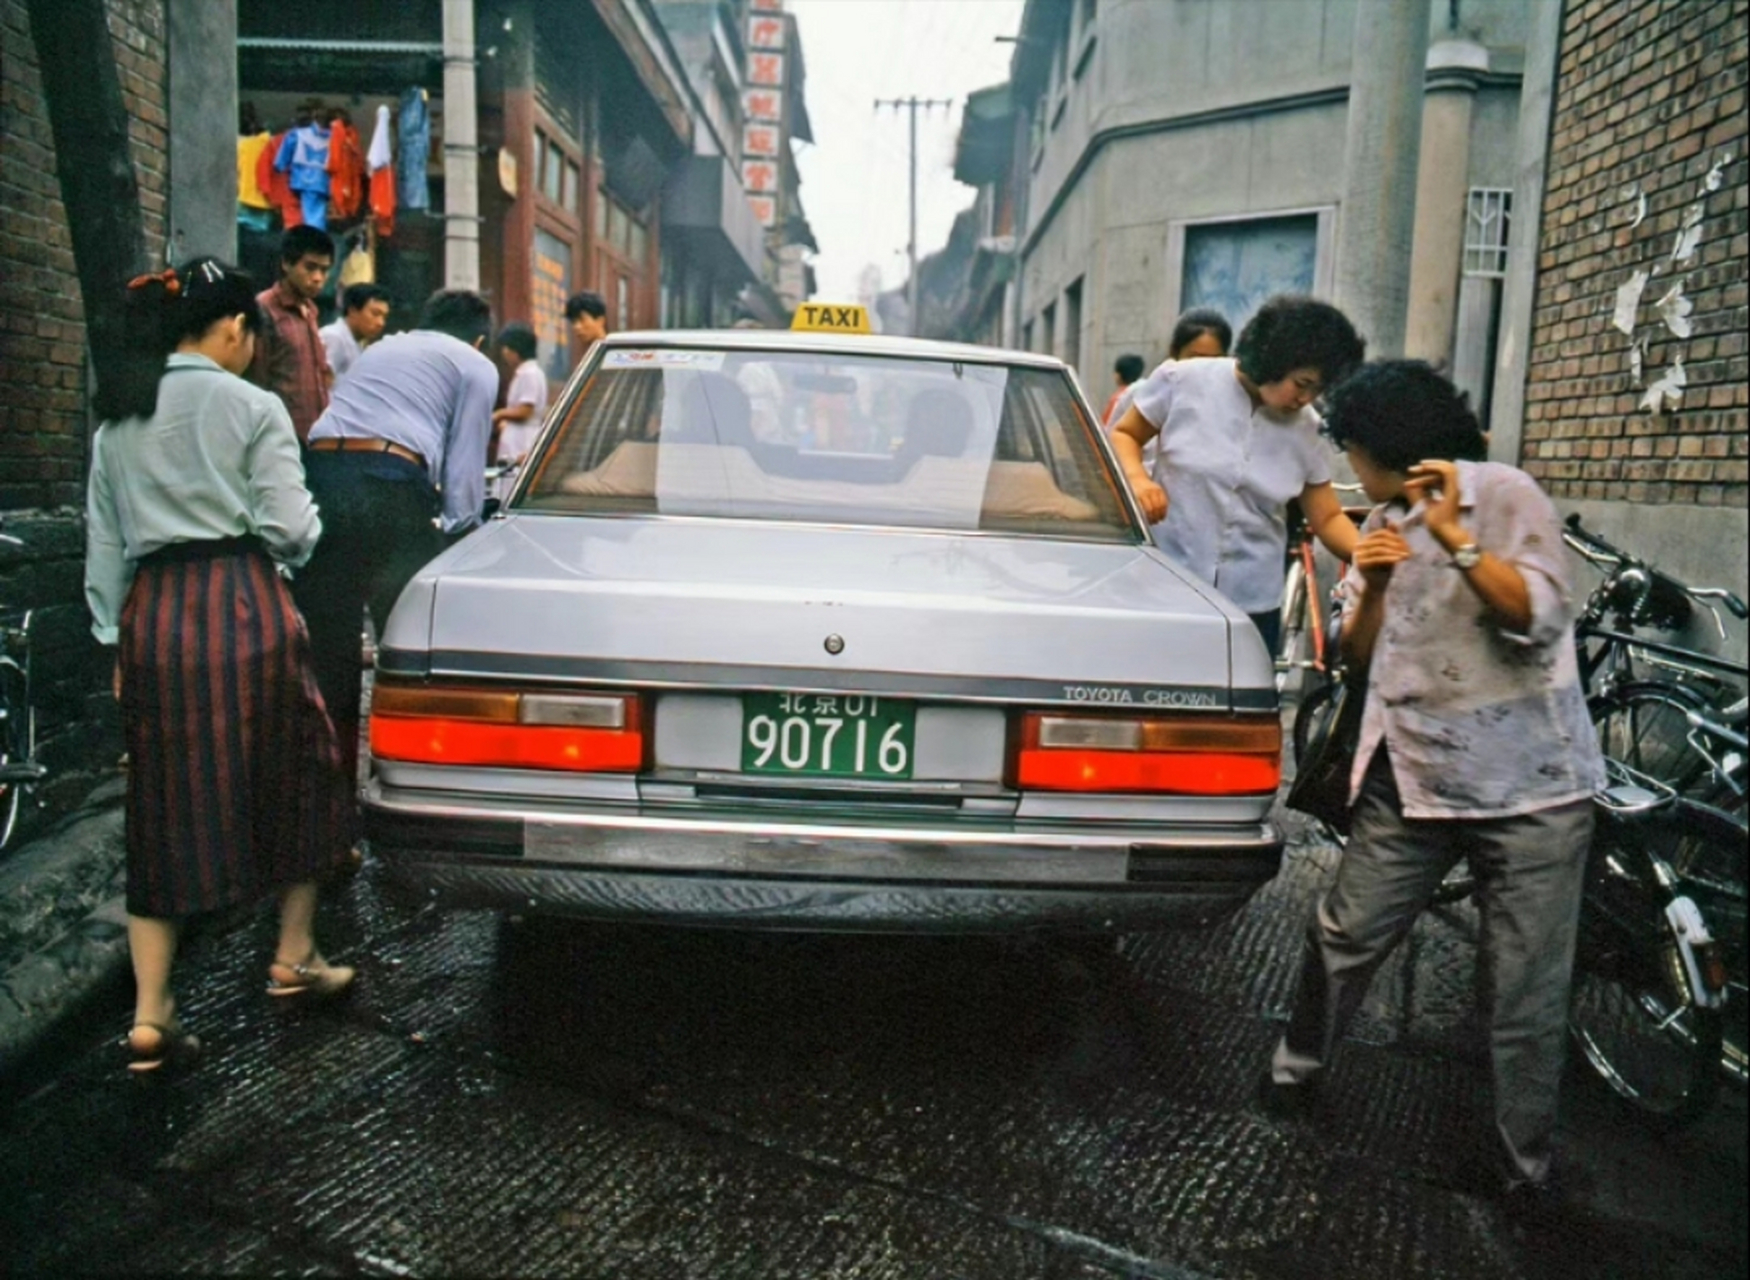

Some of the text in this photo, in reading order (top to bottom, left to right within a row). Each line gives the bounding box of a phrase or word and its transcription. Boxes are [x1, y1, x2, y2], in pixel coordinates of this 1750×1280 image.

[803, 306, 860, 327] TAXI
[1063, 686, 1216, 706] TOYOTA CROWN
[748, 715, 907, 774] 90716
